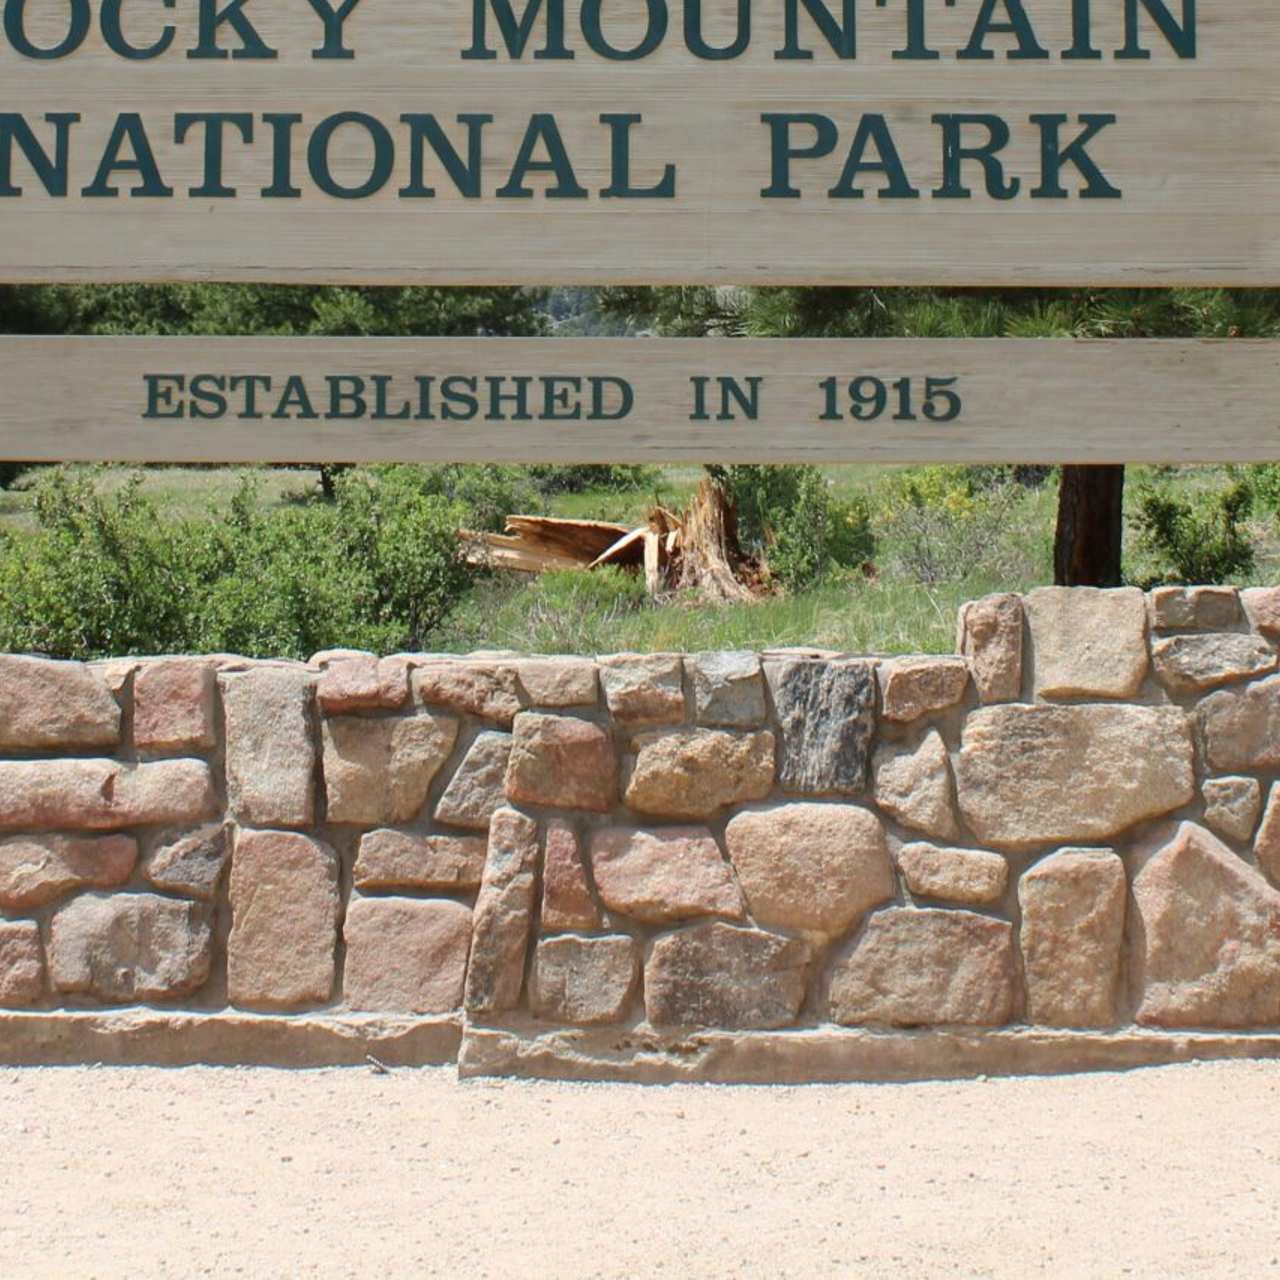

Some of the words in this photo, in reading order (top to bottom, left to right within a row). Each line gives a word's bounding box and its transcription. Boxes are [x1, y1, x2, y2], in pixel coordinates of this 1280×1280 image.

[759, 112, 1123, 201] PARK
[141, 373, 634, 422] ESTABLISHED
[689, 375, 764, 422] IN
[818, 375, 962, 423] 1915
